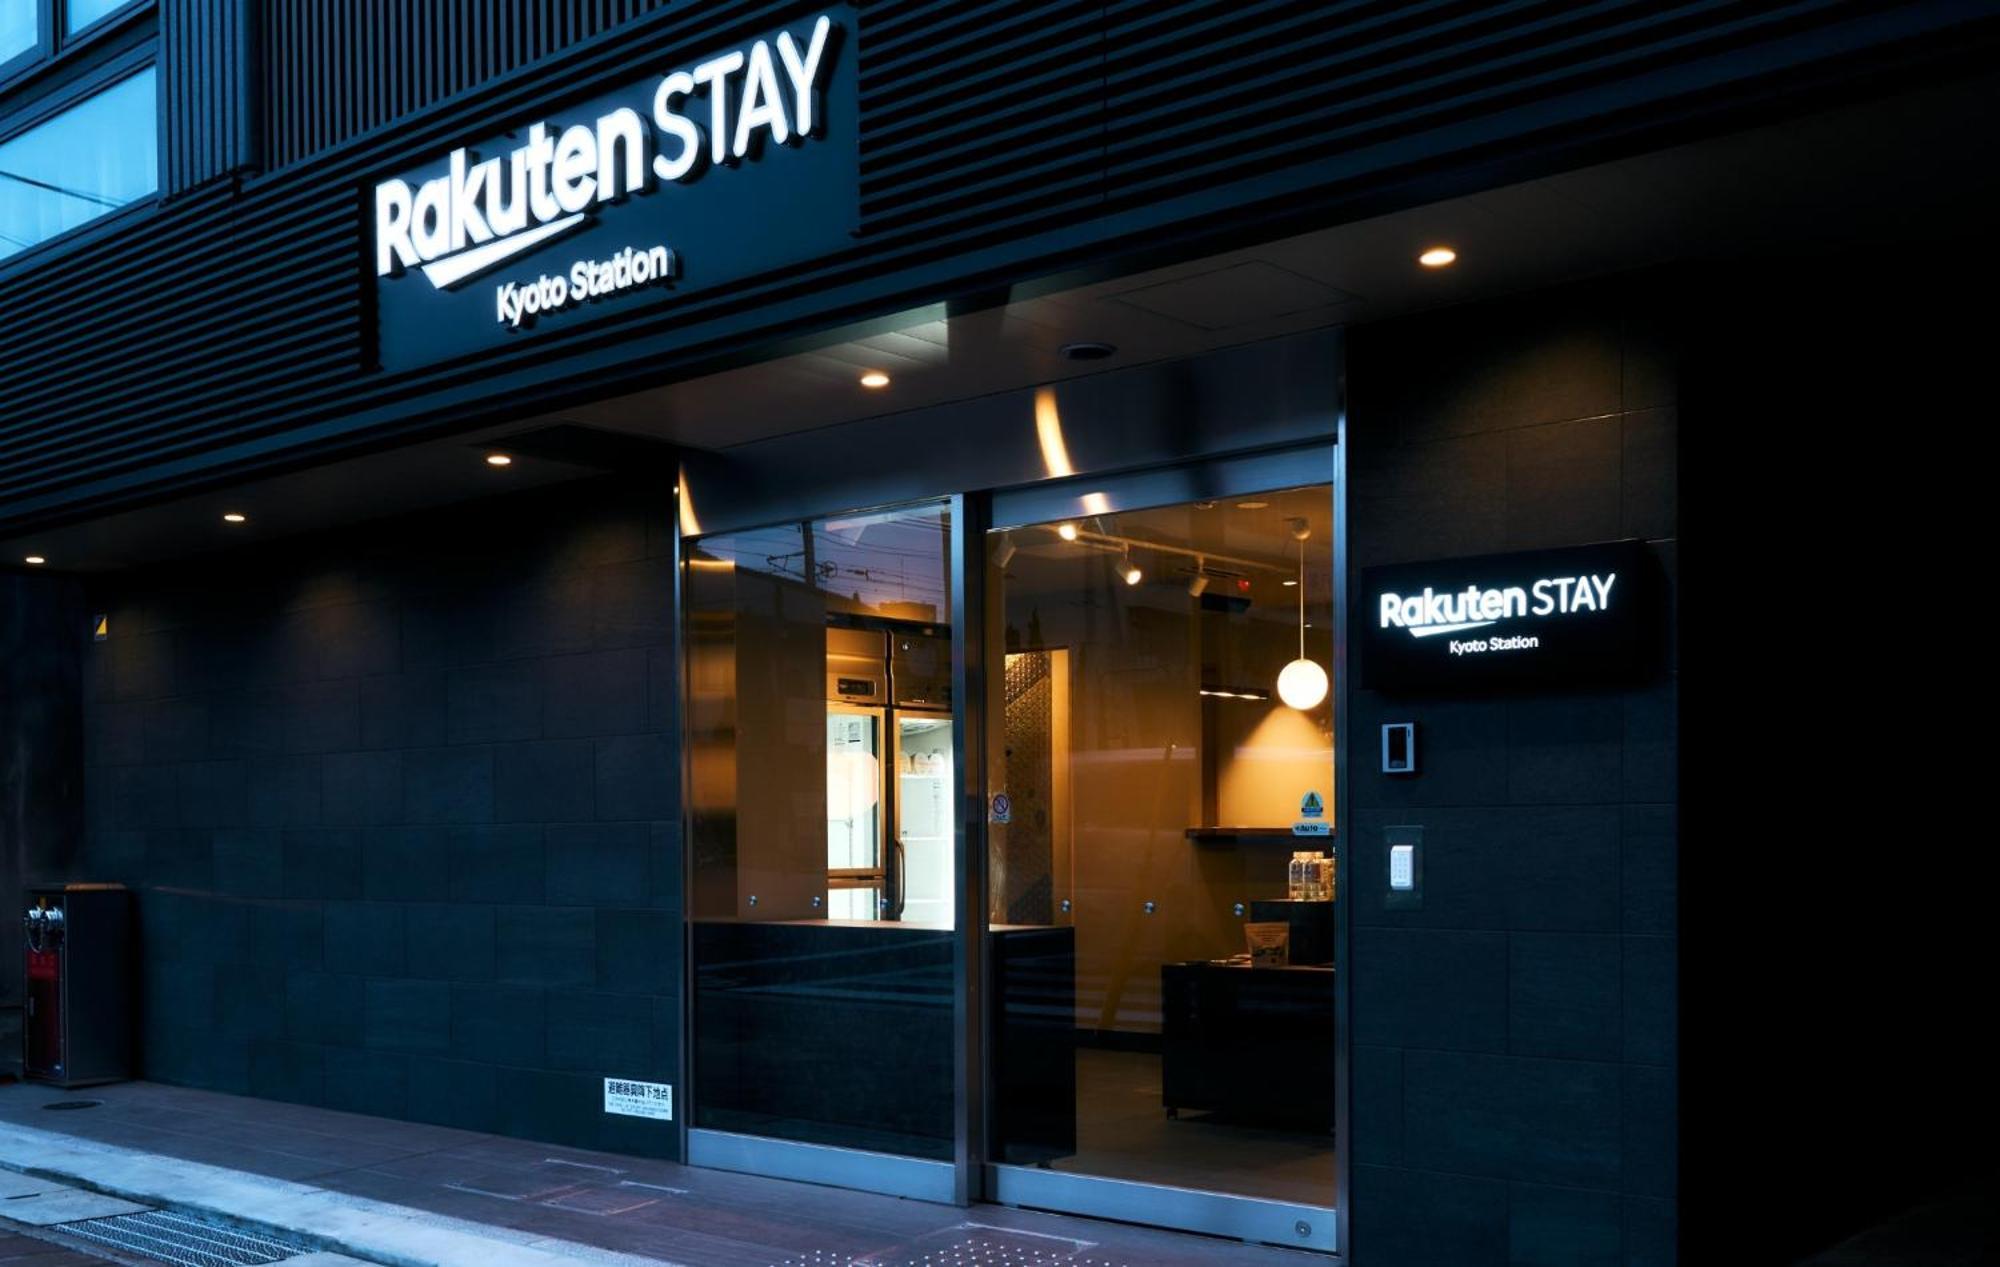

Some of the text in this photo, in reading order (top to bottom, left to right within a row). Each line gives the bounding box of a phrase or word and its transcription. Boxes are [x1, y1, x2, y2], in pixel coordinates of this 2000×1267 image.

[376, 15, 830, 276] Rakuten STAY
[496, 245, 668, 326] Kyoto Station
[1380, 573, 1616, 628] Rakuten STAY
[1449, 635, 1539, 656] Kyoto Station
